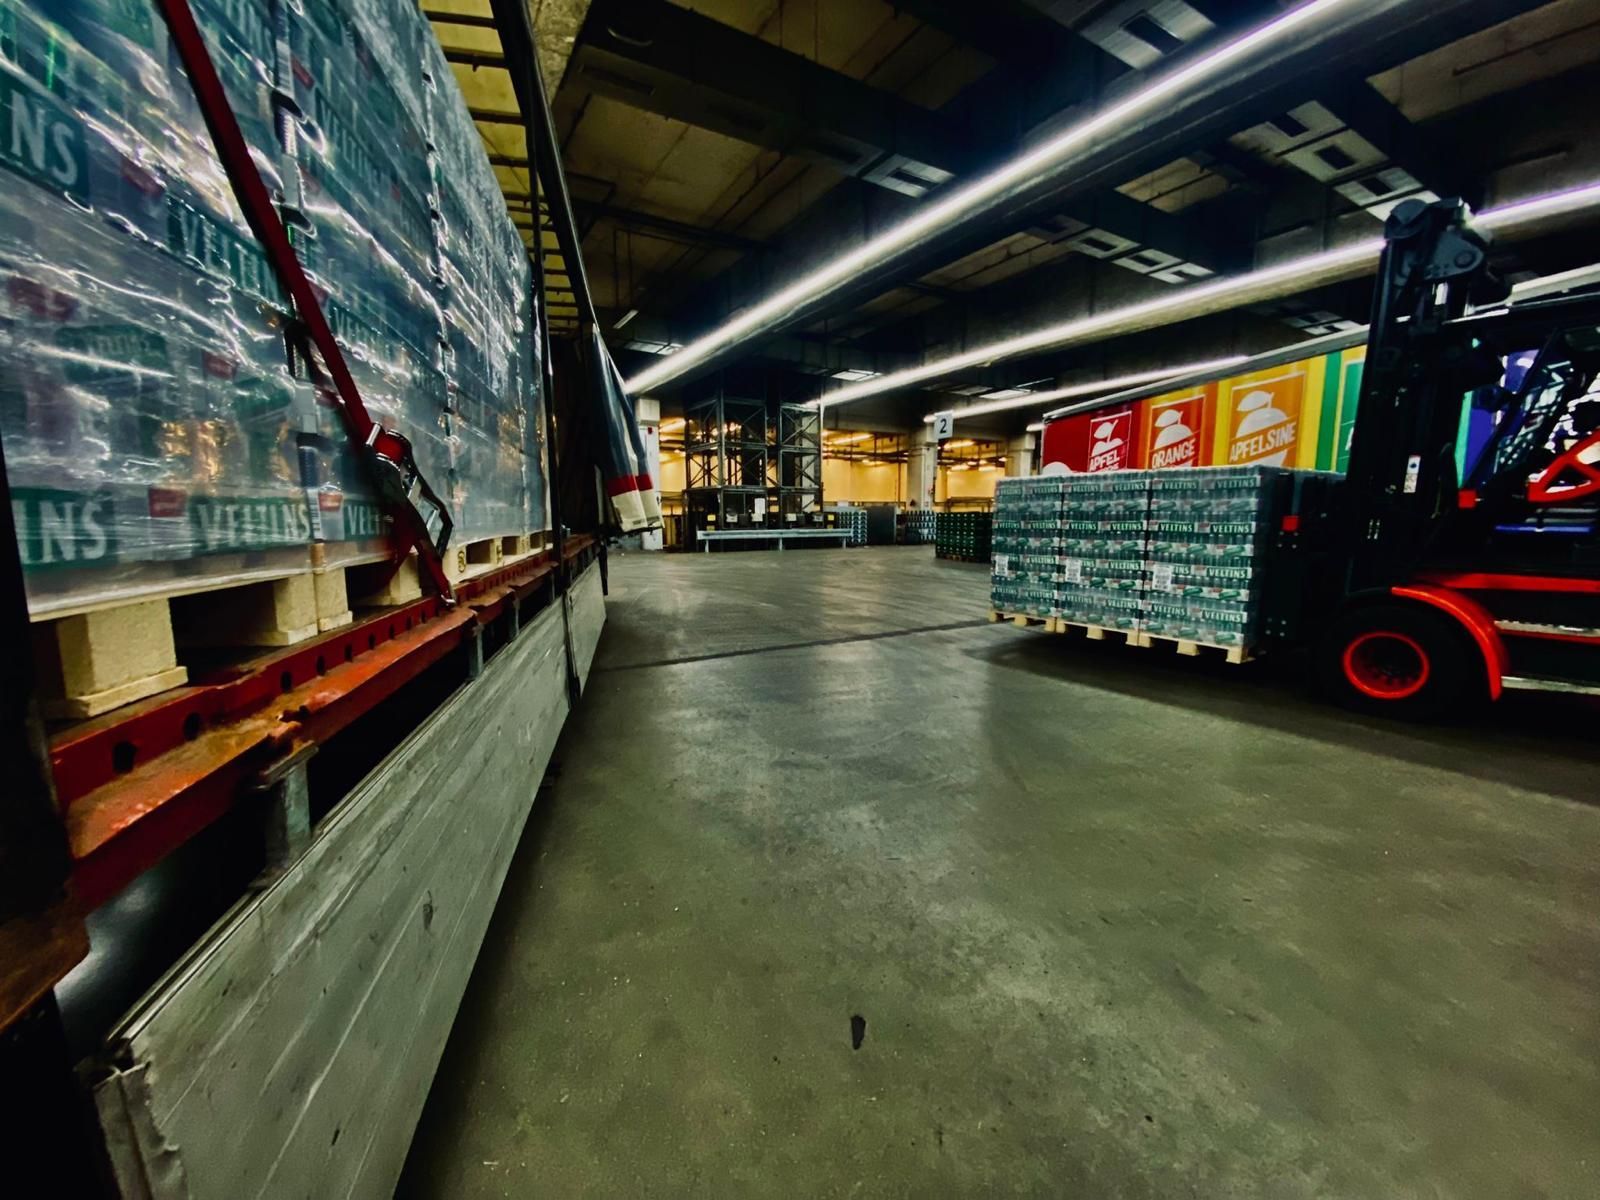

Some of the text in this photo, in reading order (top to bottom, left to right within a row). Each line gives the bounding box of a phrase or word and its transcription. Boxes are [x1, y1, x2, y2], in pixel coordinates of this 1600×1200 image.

[940, 418, 947, 434] 2
[1229, 421, 1297, 463] APFELSINE
[1152, 438, 1195, 469] ORANGE
[1090, 450, 1120, 471] APFEL
[1114, 482, 1144, 491] VELTINS
[1164, 481, 1197, 489] VELTINS
[1217, 479, 1255, 488] VELTINS
[1070, 522, 1097, 530] VELTINS
[1112, 522, 1142, 531] VELTINS
[1160, 524, 1193, 532] VELTINS
[1212, 525, 1250, 533] VELTINS
[1110, 561, 1140, 570] VELTINS
[1209, 568, 1246, 578] VELTINS
[1108, 600, 1137, 609] VELTINS
[1153, 605, 1186, 616] VELTINS
[1205, 611, 1241, 622] VELTINS
